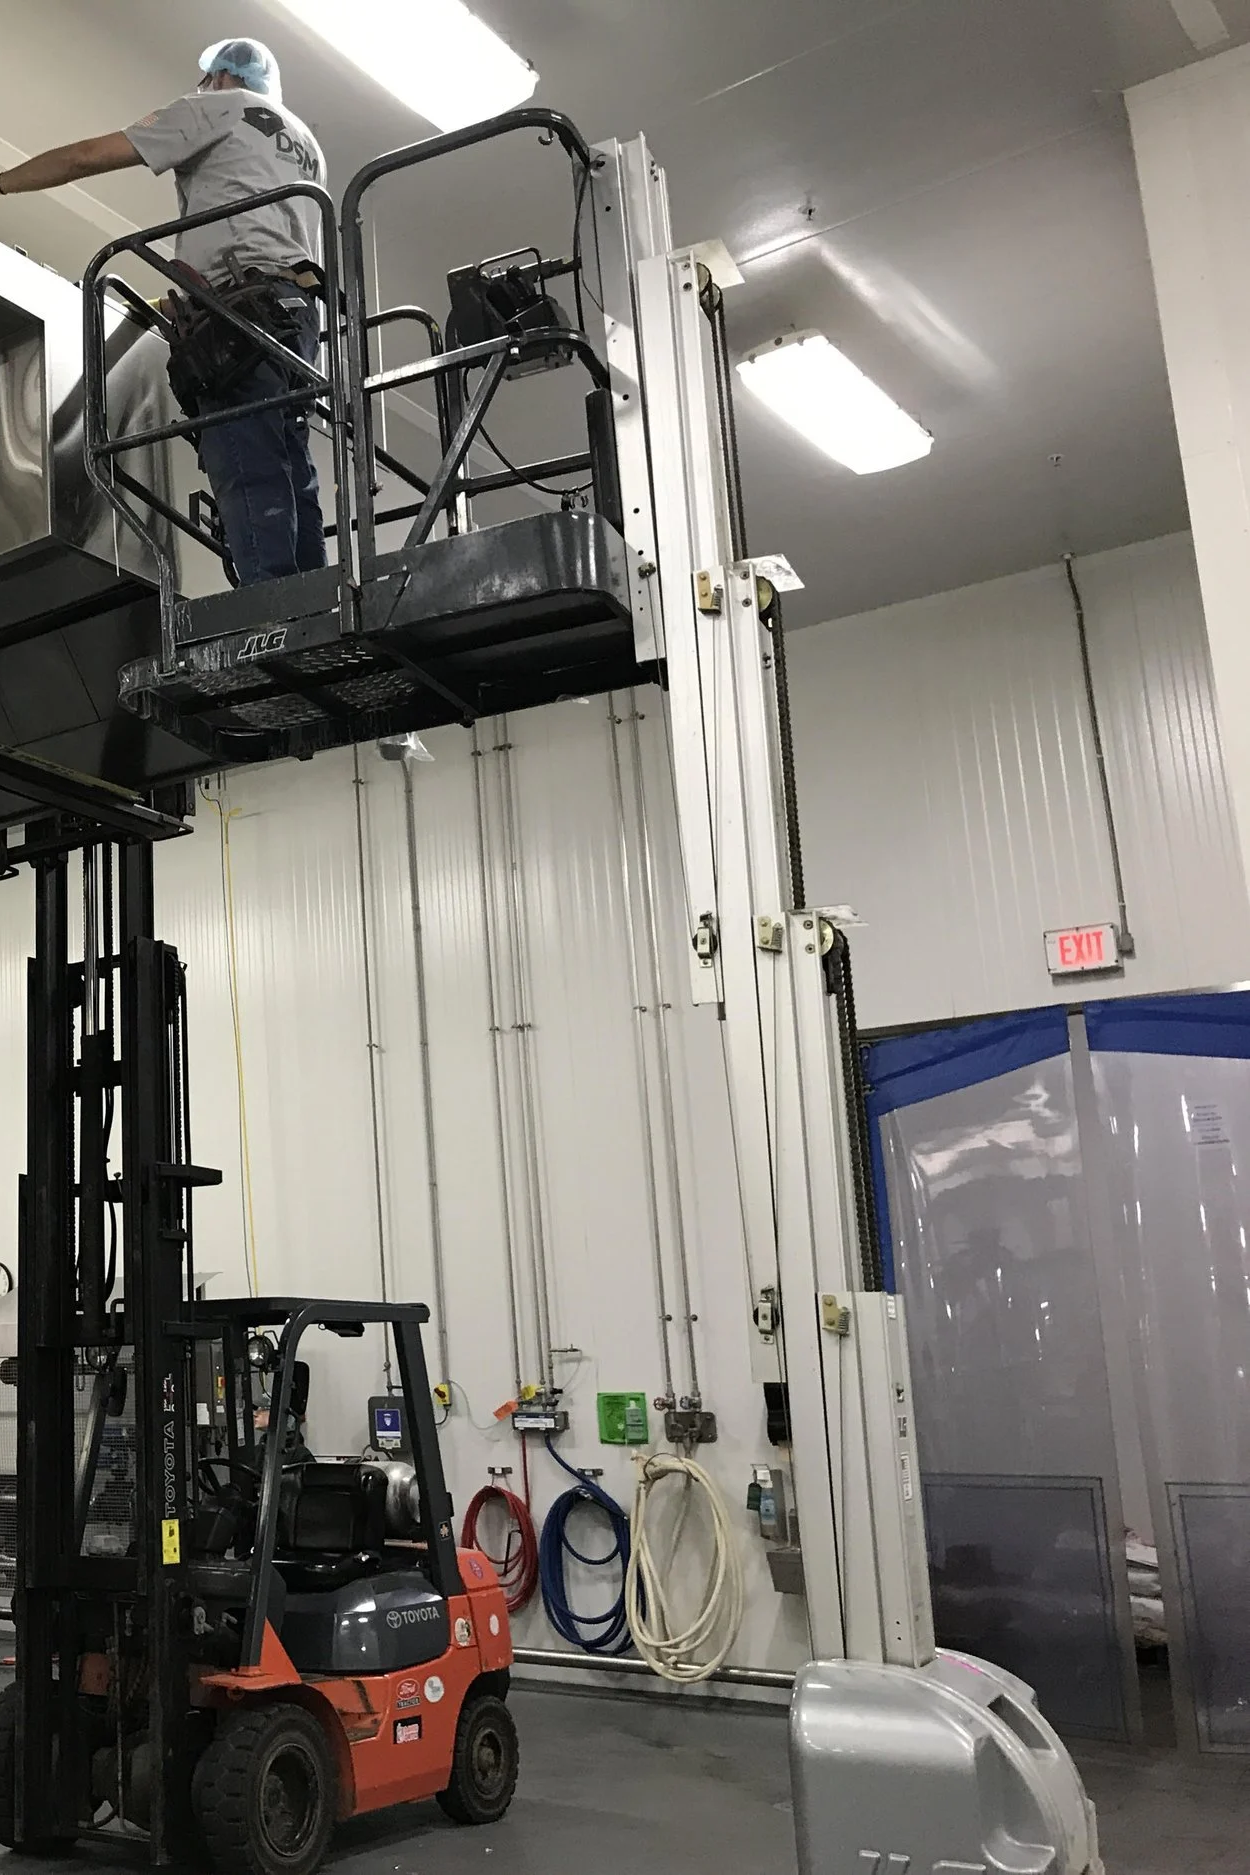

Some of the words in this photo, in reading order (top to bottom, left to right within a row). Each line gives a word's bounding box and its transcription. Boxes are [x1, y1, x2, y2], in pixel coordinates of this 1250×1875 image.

[276, 131, 319, 181] DSM
[237, 628, 287, 660] JLG
[1058, 931, 1103, 966] EXIT
[164, 1420, 176, 1518] TOYOTA
[401, 1606, 440, 1624] TOYOTA
